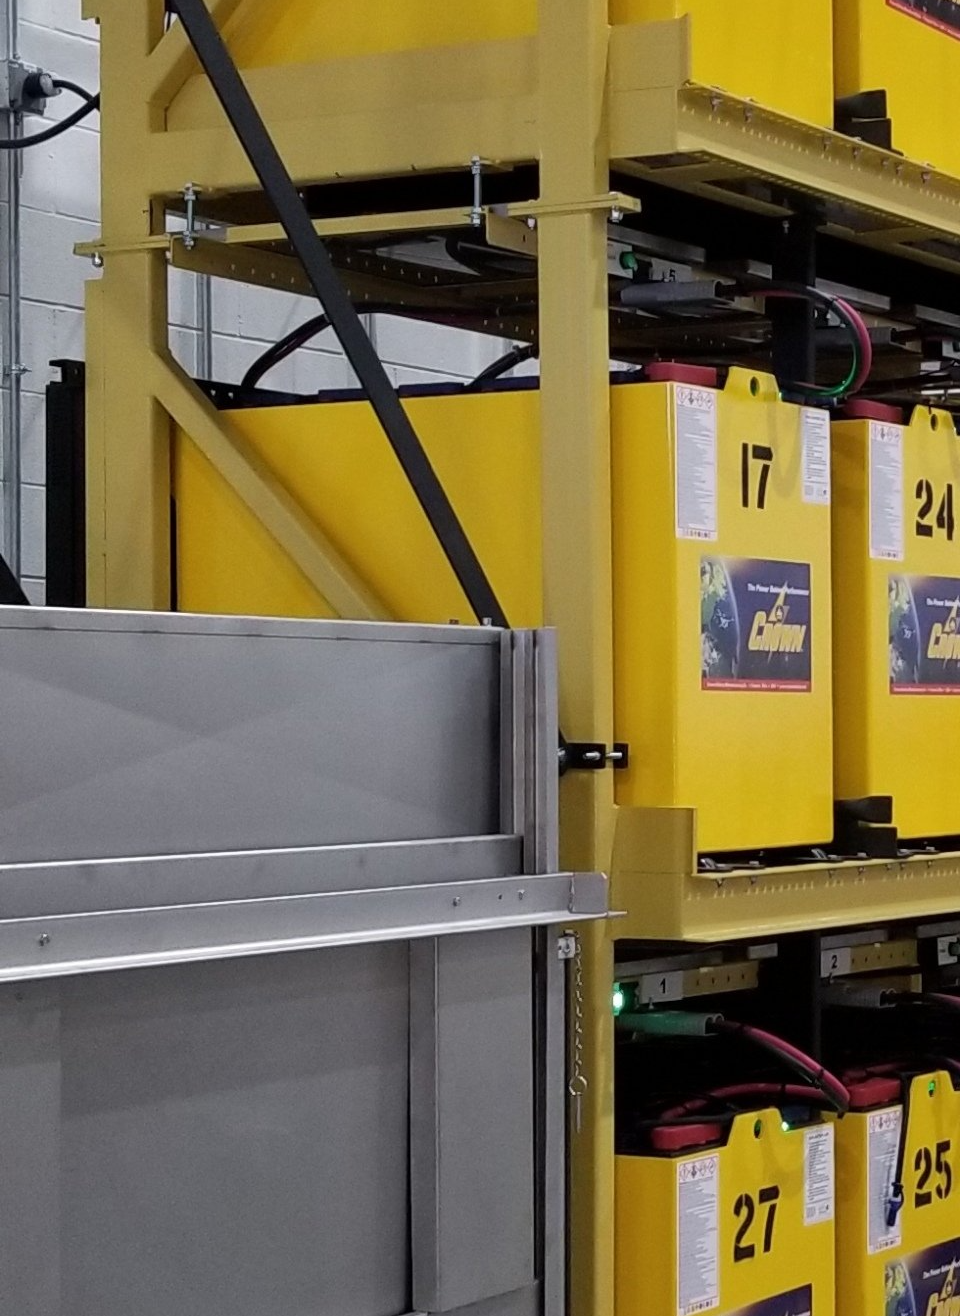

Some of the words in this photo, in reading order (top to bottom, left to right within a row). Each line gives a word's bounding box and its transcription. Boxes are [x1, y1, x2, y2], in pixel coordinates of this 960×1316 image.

[741, 442, 774, 510] 17
[915, 479, 955, 541] 24
[748, 610, 807, 652] CROWN
[659, 978, 666, 994] 1
[831, 954, 838, 970] 2
[914, 1139, 952, 1209] 25
[733, 1185, 780, 1263] 27
